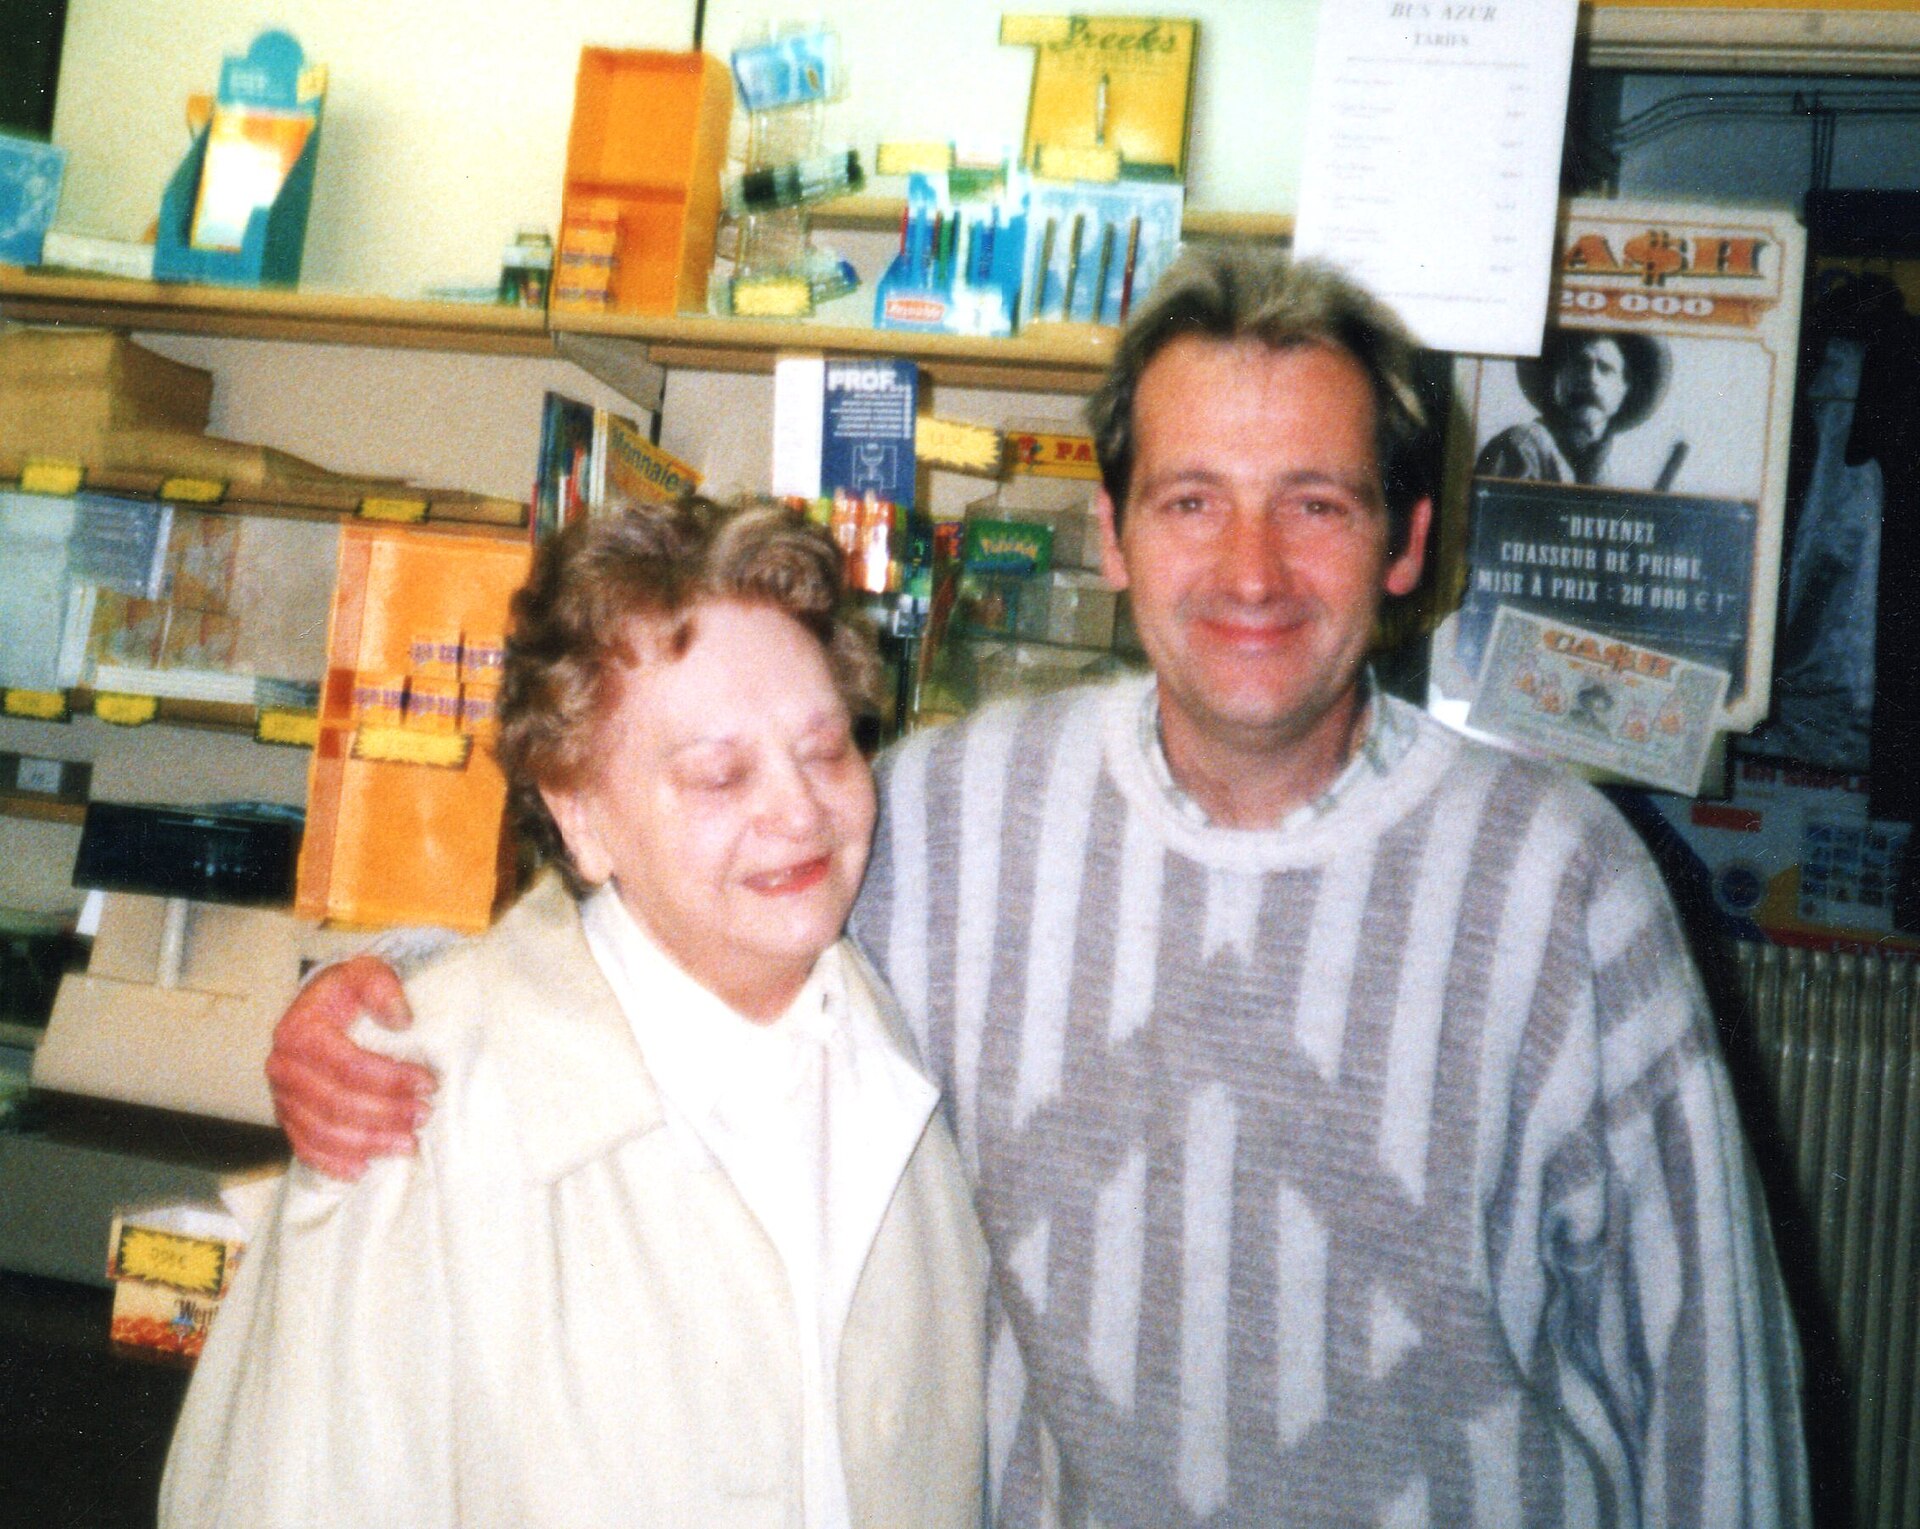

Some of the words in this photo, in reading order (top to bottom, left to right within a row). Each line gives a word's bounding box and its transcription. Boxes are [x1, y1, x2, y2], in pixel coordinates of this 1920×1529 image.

[1442, 3, 1497, 22] AZUR
[1414, 32, 1470, 47] TARIFS
[1619, 294, 1715, 316] 000
[1500, 541, 1597, 570] CHASSEUR
[1605, 548, 1630, 573] DE
[1476, 568, 1524, 595] MISE
[1551, 576, 1599, 604] PRIX
[1650, 586, 1688, 611] 000
